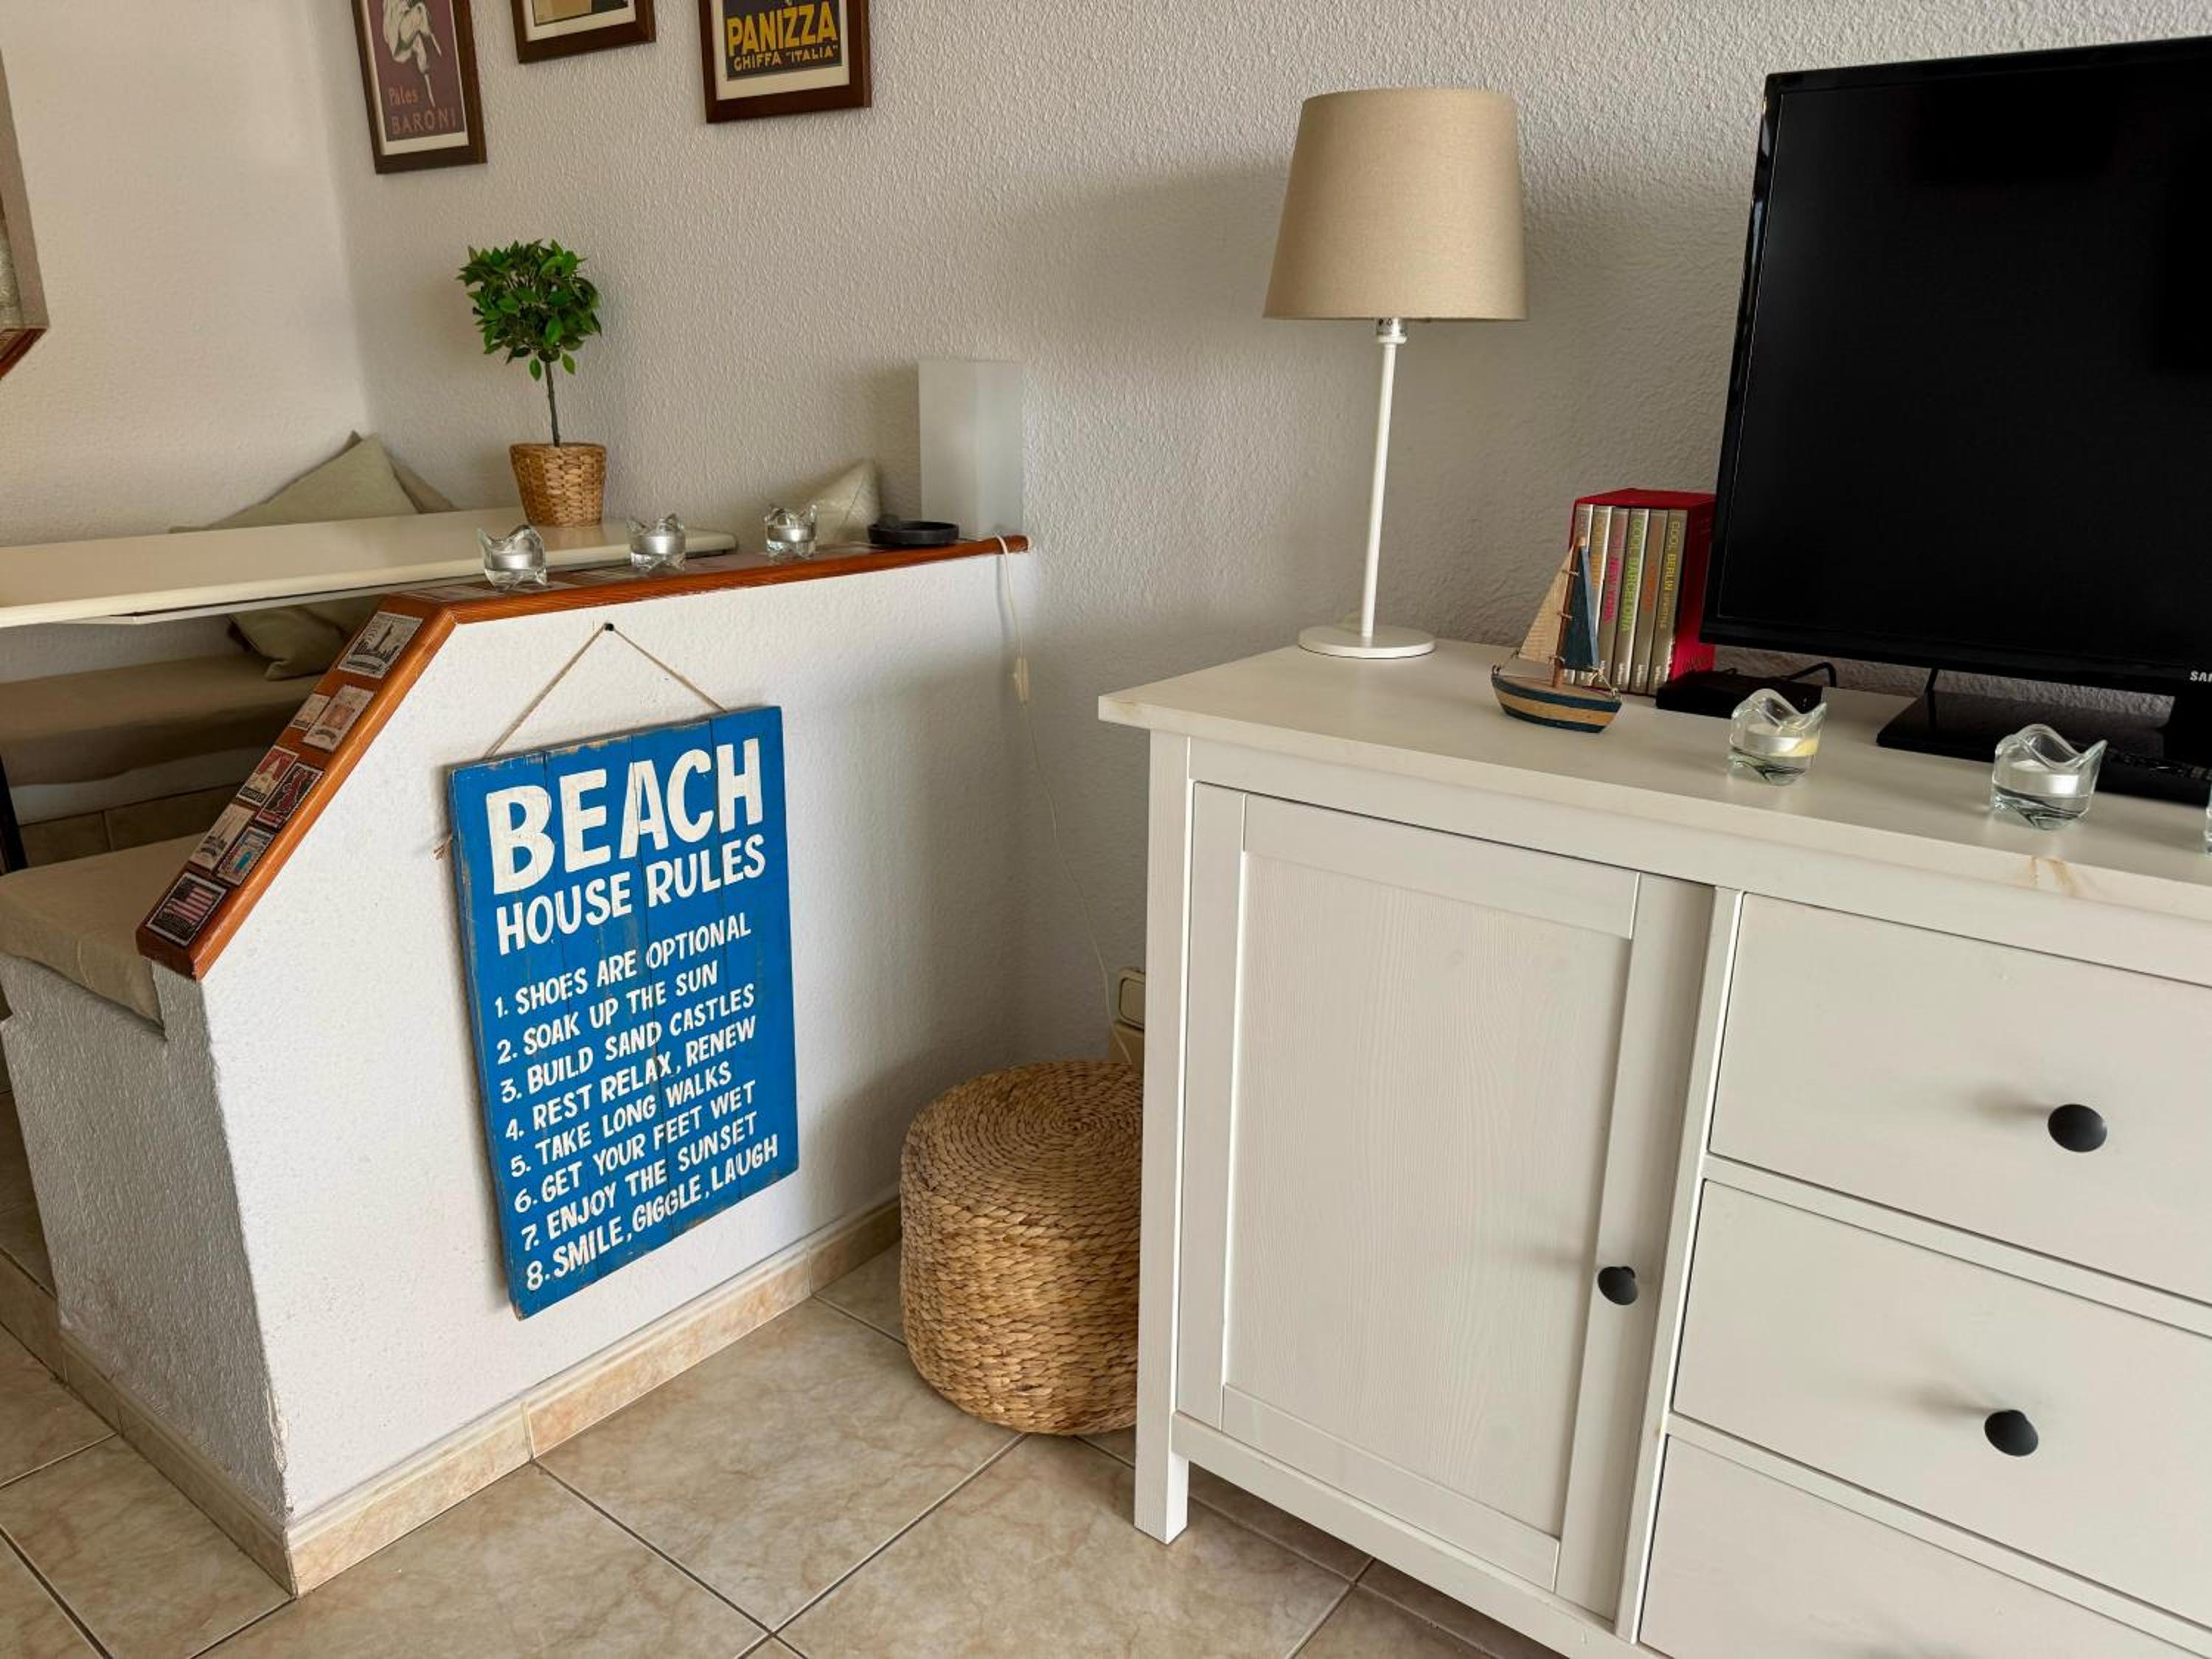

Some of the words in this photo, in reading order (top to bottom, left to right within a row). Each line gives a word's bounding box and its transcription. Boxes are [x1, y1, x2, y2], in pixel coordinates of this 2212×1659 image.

[726, 1, 837, 57] PANIZZA
[392, 106, 456, 134] BARONI
[1664, 553, 1677, 591] BERLIN
[486, 738, 763, 895] BEACH
[496, 872, 632, 956] HOUSE
[645, 834, 766, 908] RULES
[495, 997, 508, 1018] 1.
[515, 967, 588, 1015] SHOES
[597, 949, 638, 987] ARE
[645, 912, 751, 969] OPTIONAL
[497, 1039, 518, 1065] 2.
[523, 1012, 580, 1055] SOAK
[589, 998, 619, 1029] UP
[626, 981, 667, 1014] THE
[675, 960, 717, 996] SUN
[500, 1078, 522, 1104] 3.
[527, 1046, 594, 1094] BUILD
[605, 1021, 662, 1061] SAND
[669, 983, 754, 1036] CASTLES
[505, 1119, 524, 1141] 4.
[532, 1083, 592, 1130] REST
[686, 1015, 756, 1068] RENEW
[510, 1155, 532, 1178] 5.
[535, 1121, 592, 1165] TAKE
[602, 1094, 656, 1138] LONG
[665, 1061, 732, 1108] WALKS
[514, 1188, 538, 1213] 6.
[541, 1161, 582, 1203] GET
[592, 1133, 646, 1176] YOUR
[653, 1105, 702, 1150] FEET
[710, 1079, 756, 1119] WET
[711, 1134, 778, 1191] LAUGH
[521, 1223, 540, 1251] 7.
[546, 1181, 616, 1239] ENJOY
[625, 1158, 667, 1197] THE
[678, 1111, 757, 1172] SUNSET
